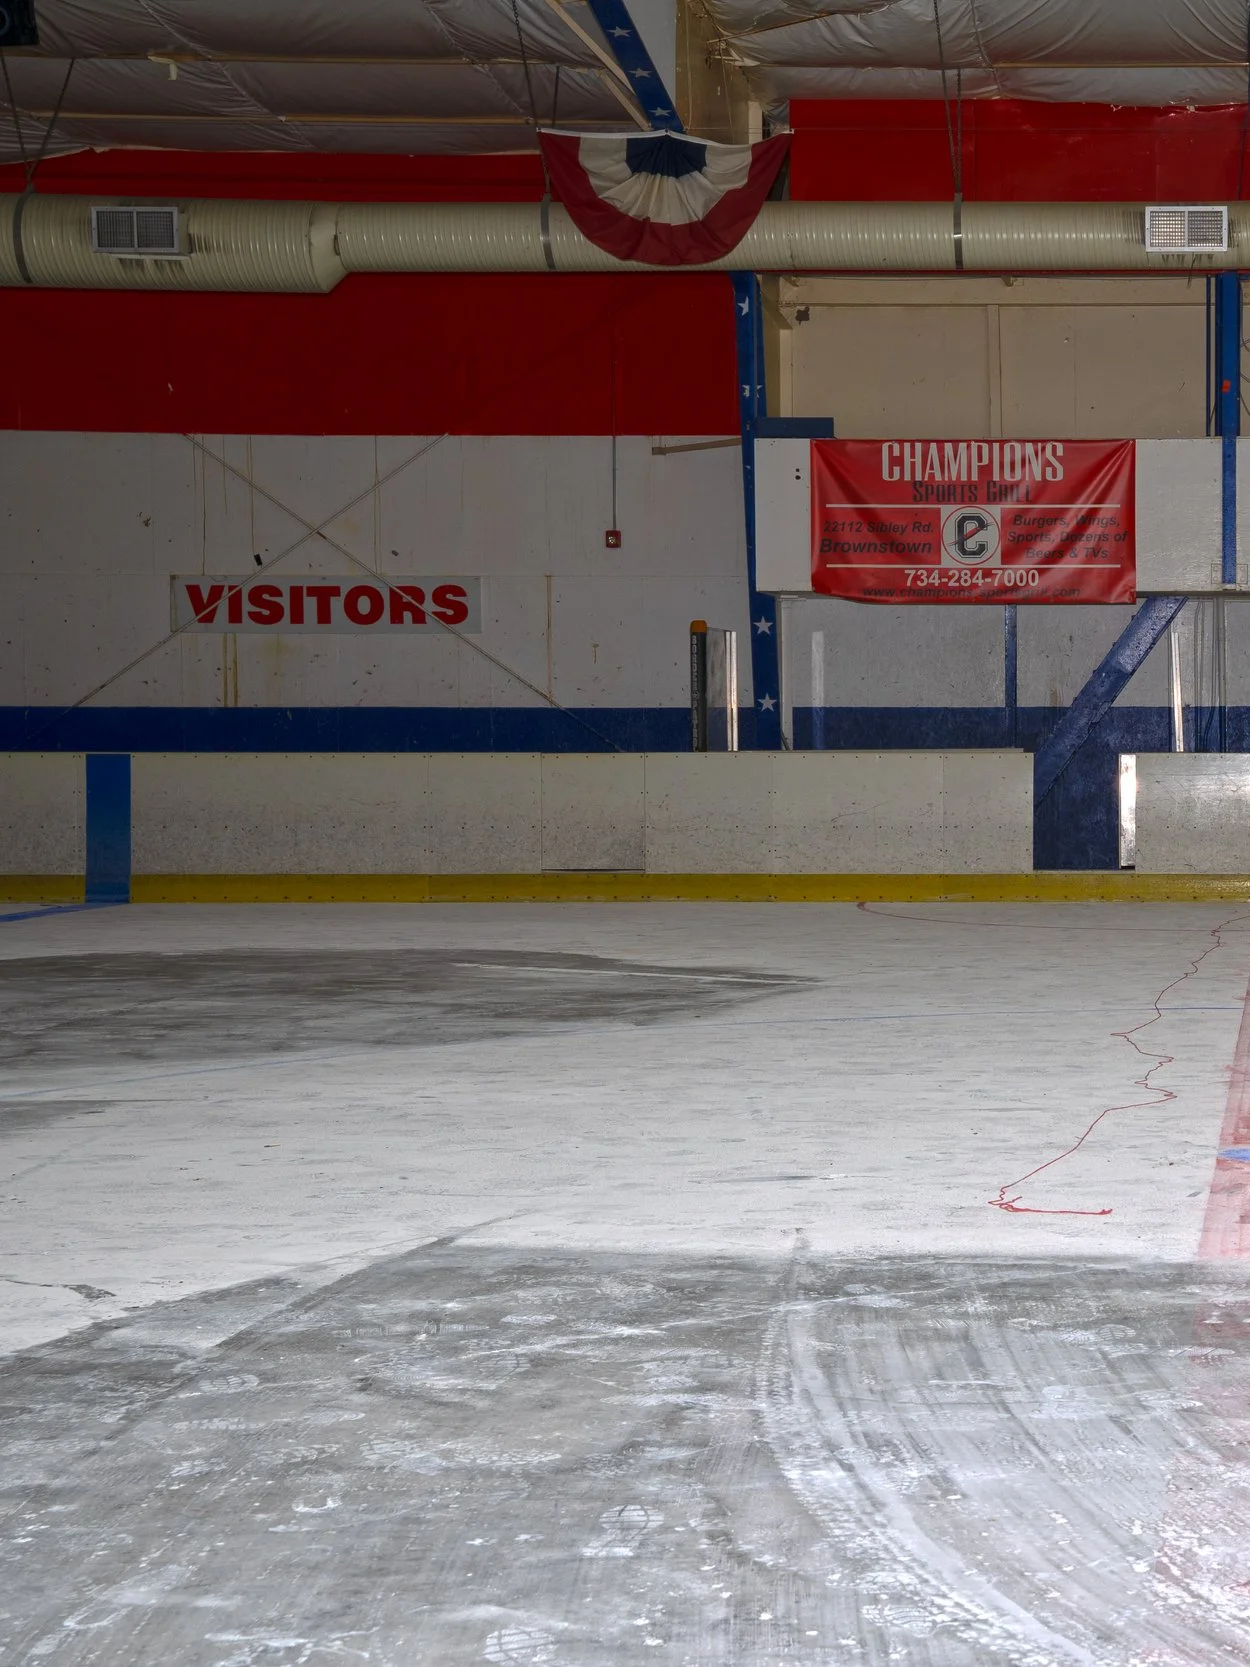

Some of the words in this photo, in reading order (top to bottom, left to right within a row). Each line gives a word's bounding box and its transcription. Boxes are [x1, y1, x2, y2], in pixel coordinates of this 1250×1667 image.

[882, 442, 1064, 482] CHAMPIONS
[912, 481, 978, 503] SPORTS
[824, 521, 862, 533] 22112
[867, 521, 907, 536] Sibley
[912, 521, 934, 533] Rd.
[1013, 515, 1070, 529] Burgers,
[1075, 515, 1121, 529] Wings,
[1008, 531, 1055, 544] Sports,
[1060, 531, 1111, 543] Dozens
[1114, 530, 1128, 542] of
[820, 539, 932, 555] Brownstown
[1026, 547, 1066, 559] Beers
[1069, 548, 1078, 558] &
[1083, 547, 1109, 559] TVs
[905, 569, 1040, 587] 734-284-7000
[185, 584, 469, 625] VISITORS
